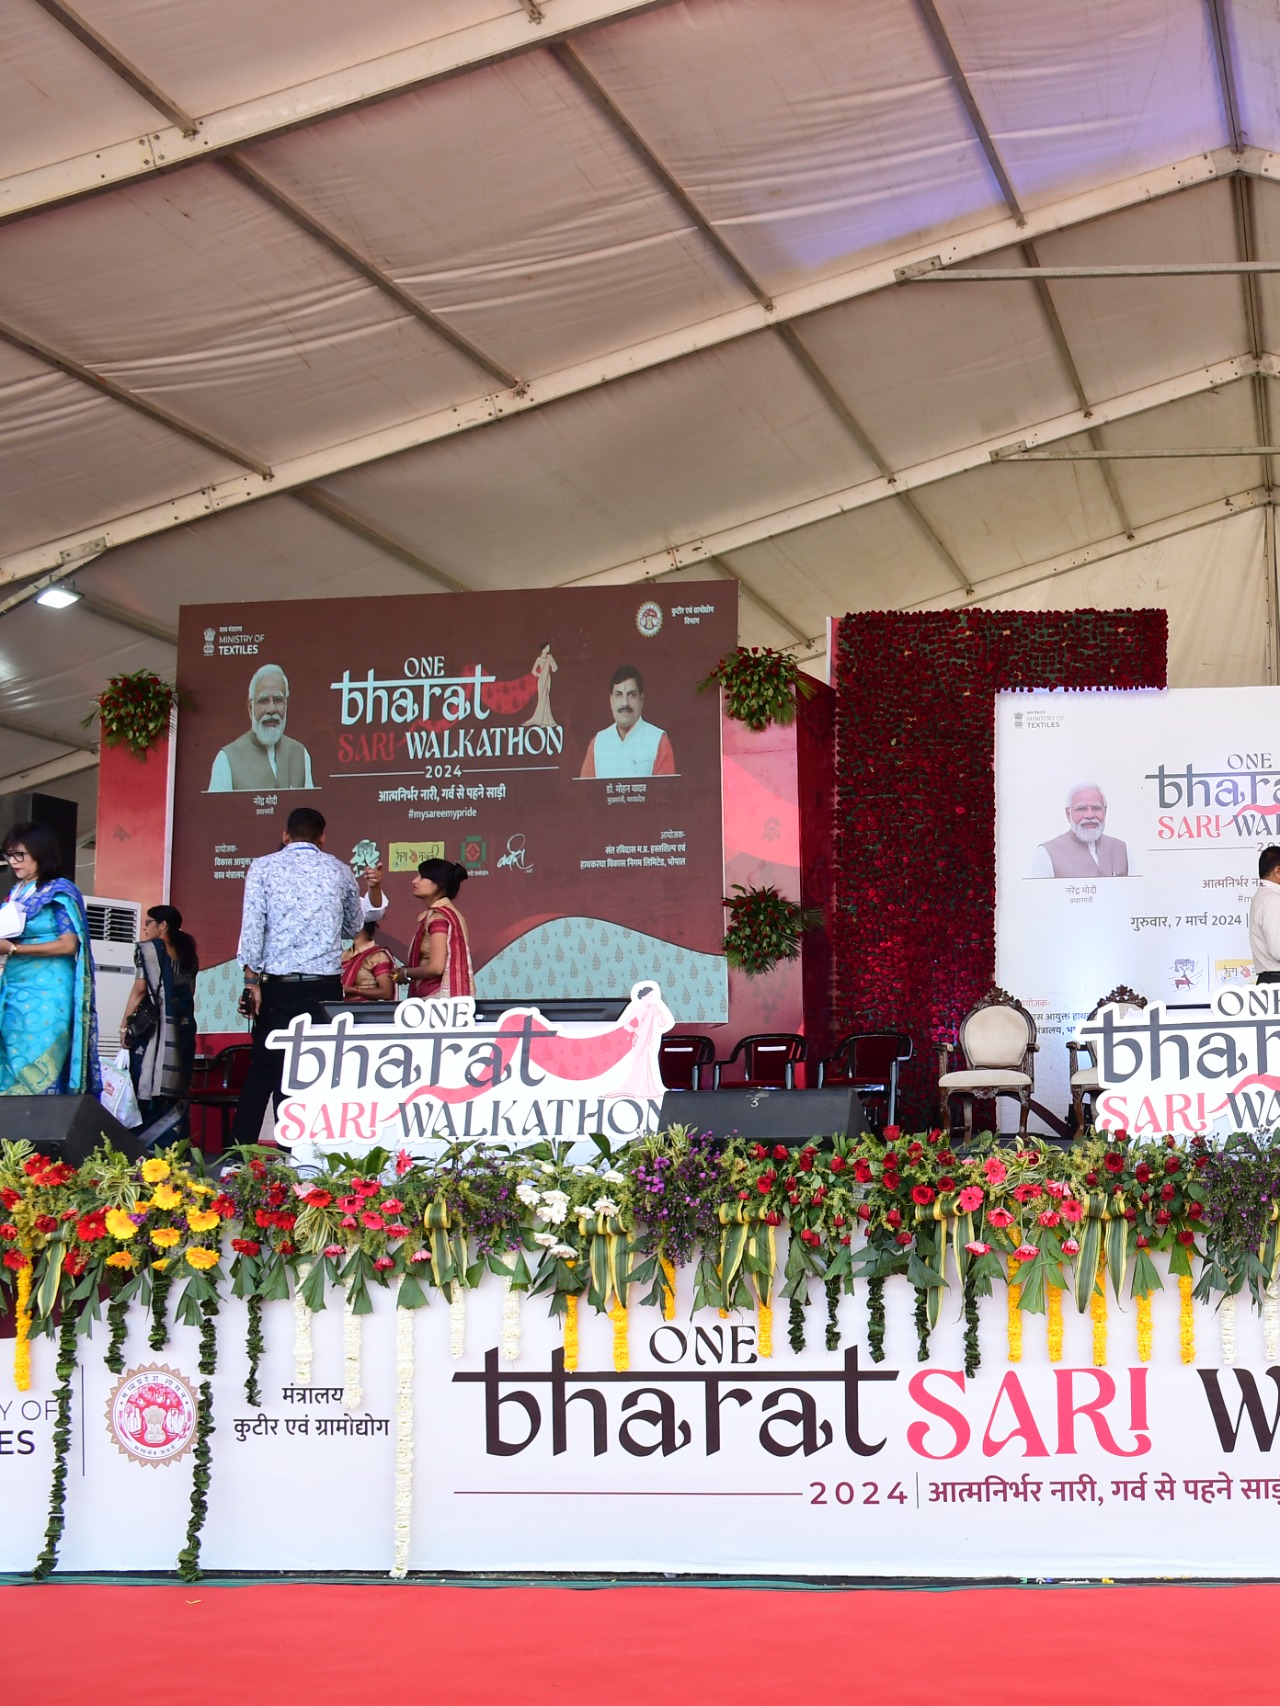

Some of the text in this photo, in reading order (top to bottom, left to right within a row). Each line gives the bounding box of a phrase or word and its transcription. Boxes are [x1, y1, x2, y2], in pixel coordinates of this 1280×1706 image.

[218, 644, 259, 656] TEXTILES
[219, 634, 265, 644] MINISTRY OF
[403, 656, 445, 678] ONE
[330, 663, 496, 725] bharat
[337, 725, 563, 763] SARI WALKATHON
[425, 765, 462, 779] 2024
[1227, 753, 1273, 769] ONE
[378, 783, 506, 802] आत्मनिर्भर नारी, गर्व से पहने साड़ी
[408, 807, 477, 821] #mysareemypride
[1158, 815, 1222, 840] SARI
[1082, 884, 1097, 894] मोदी
[1202, 875, 1248, 889] आत्मनिर्भर
[1130, 913, 1242, 932] गुरुवार, 7 मार्च 2024
[401, 1002, 470, 1029] ONE
[272, 1015, 557, 1090] bharat
[280, 1101, 379, 1140] SARI
[1102, 1092, 1207, 1133] SARI
[649, 1325, 758, 1364] ONE
[282, 1386, 344, 1405] मंत्रालय
[452, 1345, 900, 1458] bharat
[906, 1366, 1153, 1460] SARI
[21, 1400, 58, 1421] OF
[234, 1413, 390, 1442] कुटीर एवं ग्रामोद्योग
[809, 1480, 908, 1505] 2024
[927, 1472, 1043, 1503] आत्मनिर्भर
[1050, 1472, 1104, 1506] नारी,
[1111, 1472, 1147, 1501] गर्व
[1154, 1472, 1177, 1501] से
[1184, 1471, 1235, 1504] पहने
